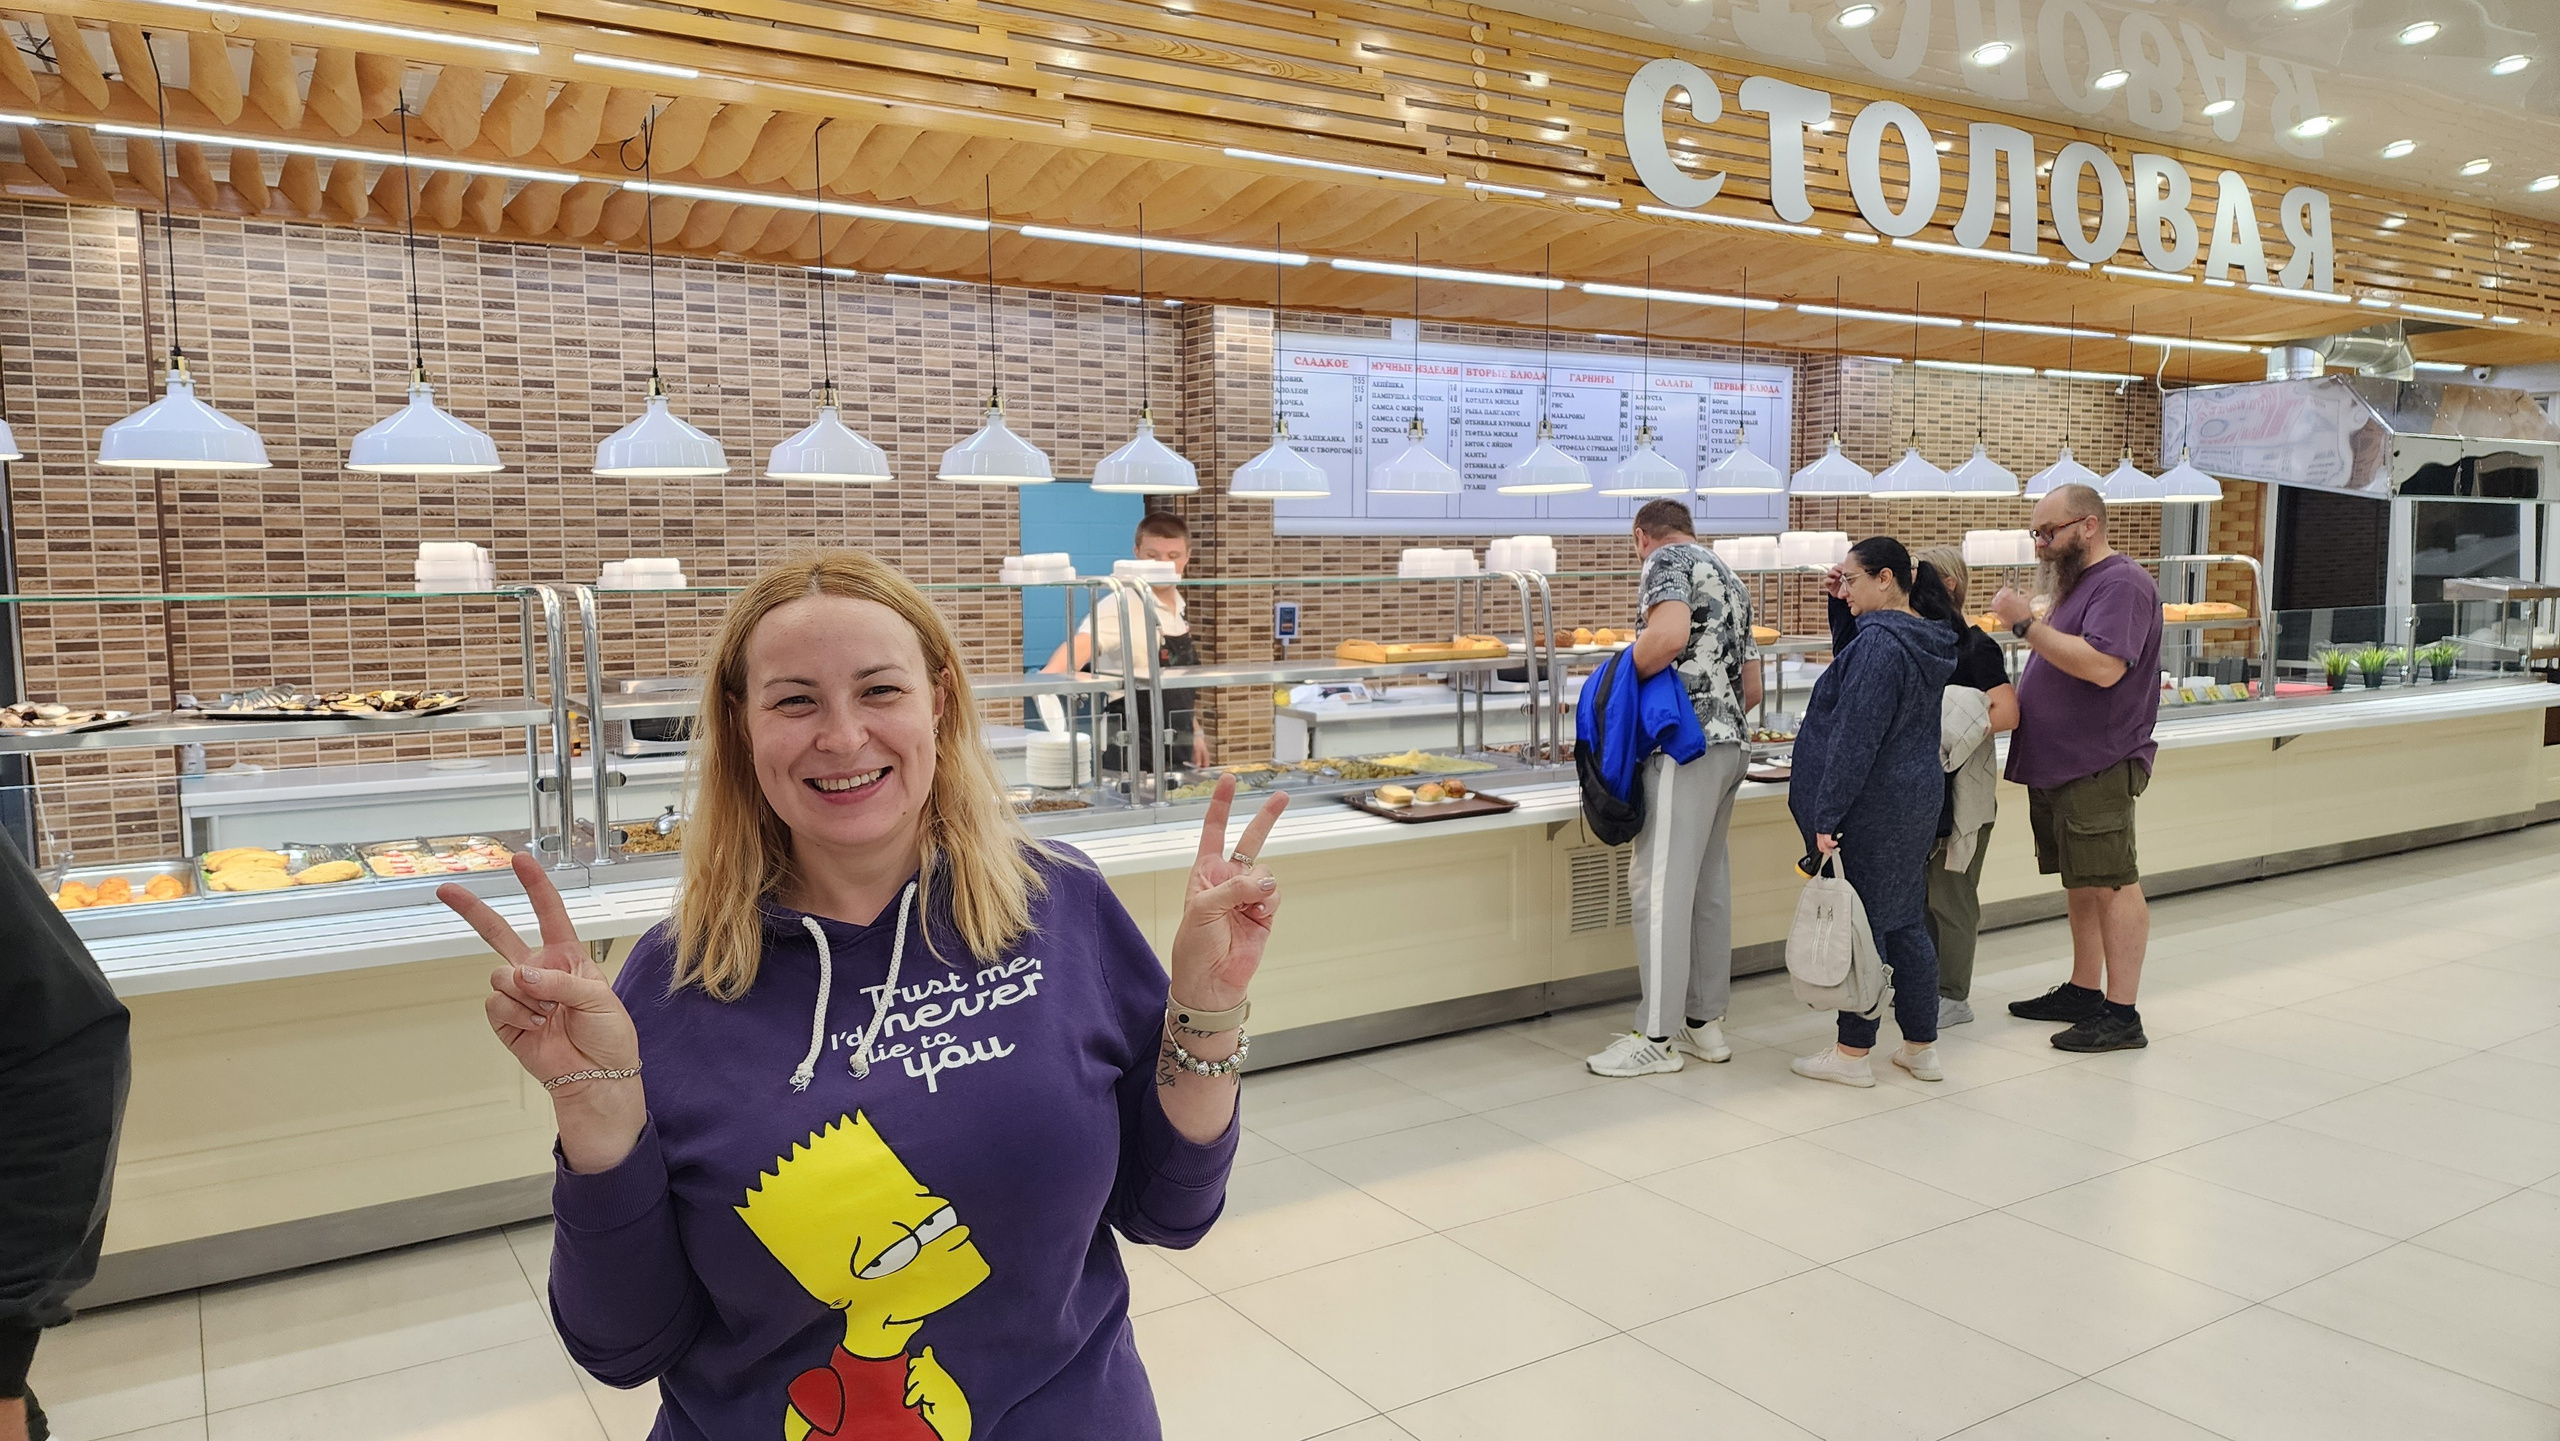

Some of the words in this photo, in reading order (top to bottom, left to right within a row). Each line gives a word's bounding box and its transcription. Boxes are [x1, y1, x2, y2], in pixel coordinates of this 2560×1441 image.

[1623, 58, 2335, 292] СТОЛОВАЯ
[1294, 356, 1349, 368] СЛАДКОЕ
[1371, 361, 1413, 373] МУЧНЫЕ
[1416, 364, 1459, 376] ИЗДЕЛИЯ
[1465, 367, 1508, 379] ВТОРЫЕ
[1510, 370, 1546, 381] БЛЮДА
[1569, 373, 1615, 384] ГАРНИРЫ
[1655, 378, 1693, 389] САЛАТЫ
[1750, 383, 1780, 394] БЛЮДА
[1275, 387, 1309, 395] АПОЛЕОН
[1274, 399, 1304, 407] УЛОЧКА
[1635, 394, 1663, 402] КАУСТА
[860, 972, 968, 1011] Trust
[883, 971, 1043, 1037] never
[920, 1032, 957, 1049] to
[903, 1036, 1016, 1093] you
